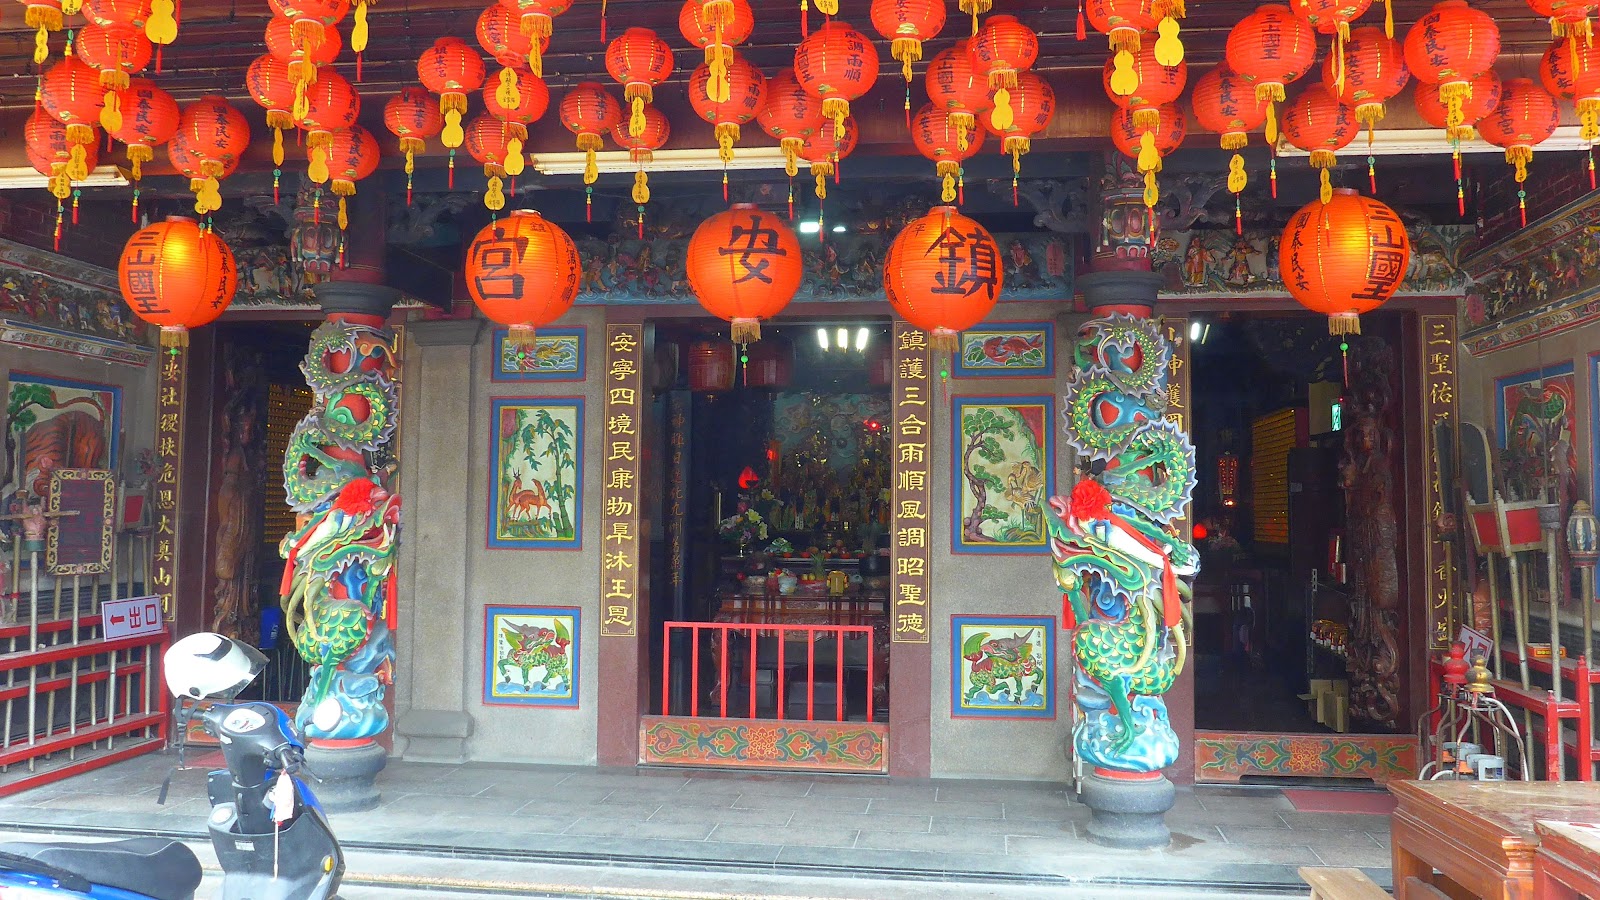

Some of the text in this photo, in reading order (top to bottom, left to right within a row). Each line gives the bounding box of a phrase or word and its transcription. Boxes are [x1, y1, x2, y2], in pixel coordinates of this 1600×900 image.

[434, 46, 449, 78] 鎮安宮
[844, 31, 864, 82] 風調雨順
[1259, 13, 1282, 60] 三山國王
[1422, 13, 1449, 67] 國泰民安
[937, 51, 956, 95] 三山國王
[136, 89, 153, 135] 國泰民安
[212, 106, 231, 149] 國泰民安
[127, 231, 171, 314] 三山國王
[211, 240, 230, 309] 國泰民安
[473, 227, 529, 300] 宮
[718, 215, 787, 284] 安
[924, 226, 998, 301] 鎮
[1291, 212, 1311, 292] 國泰民安
[1351, 203, 1404, 301] 三山國王
[605, 332, 638, 627] 安寧四境民康物阜沐王恩
[896, 329, 928, 634] 鎮護三合雨順風調昭聖德
[129, 604, 157, 629] 出口
